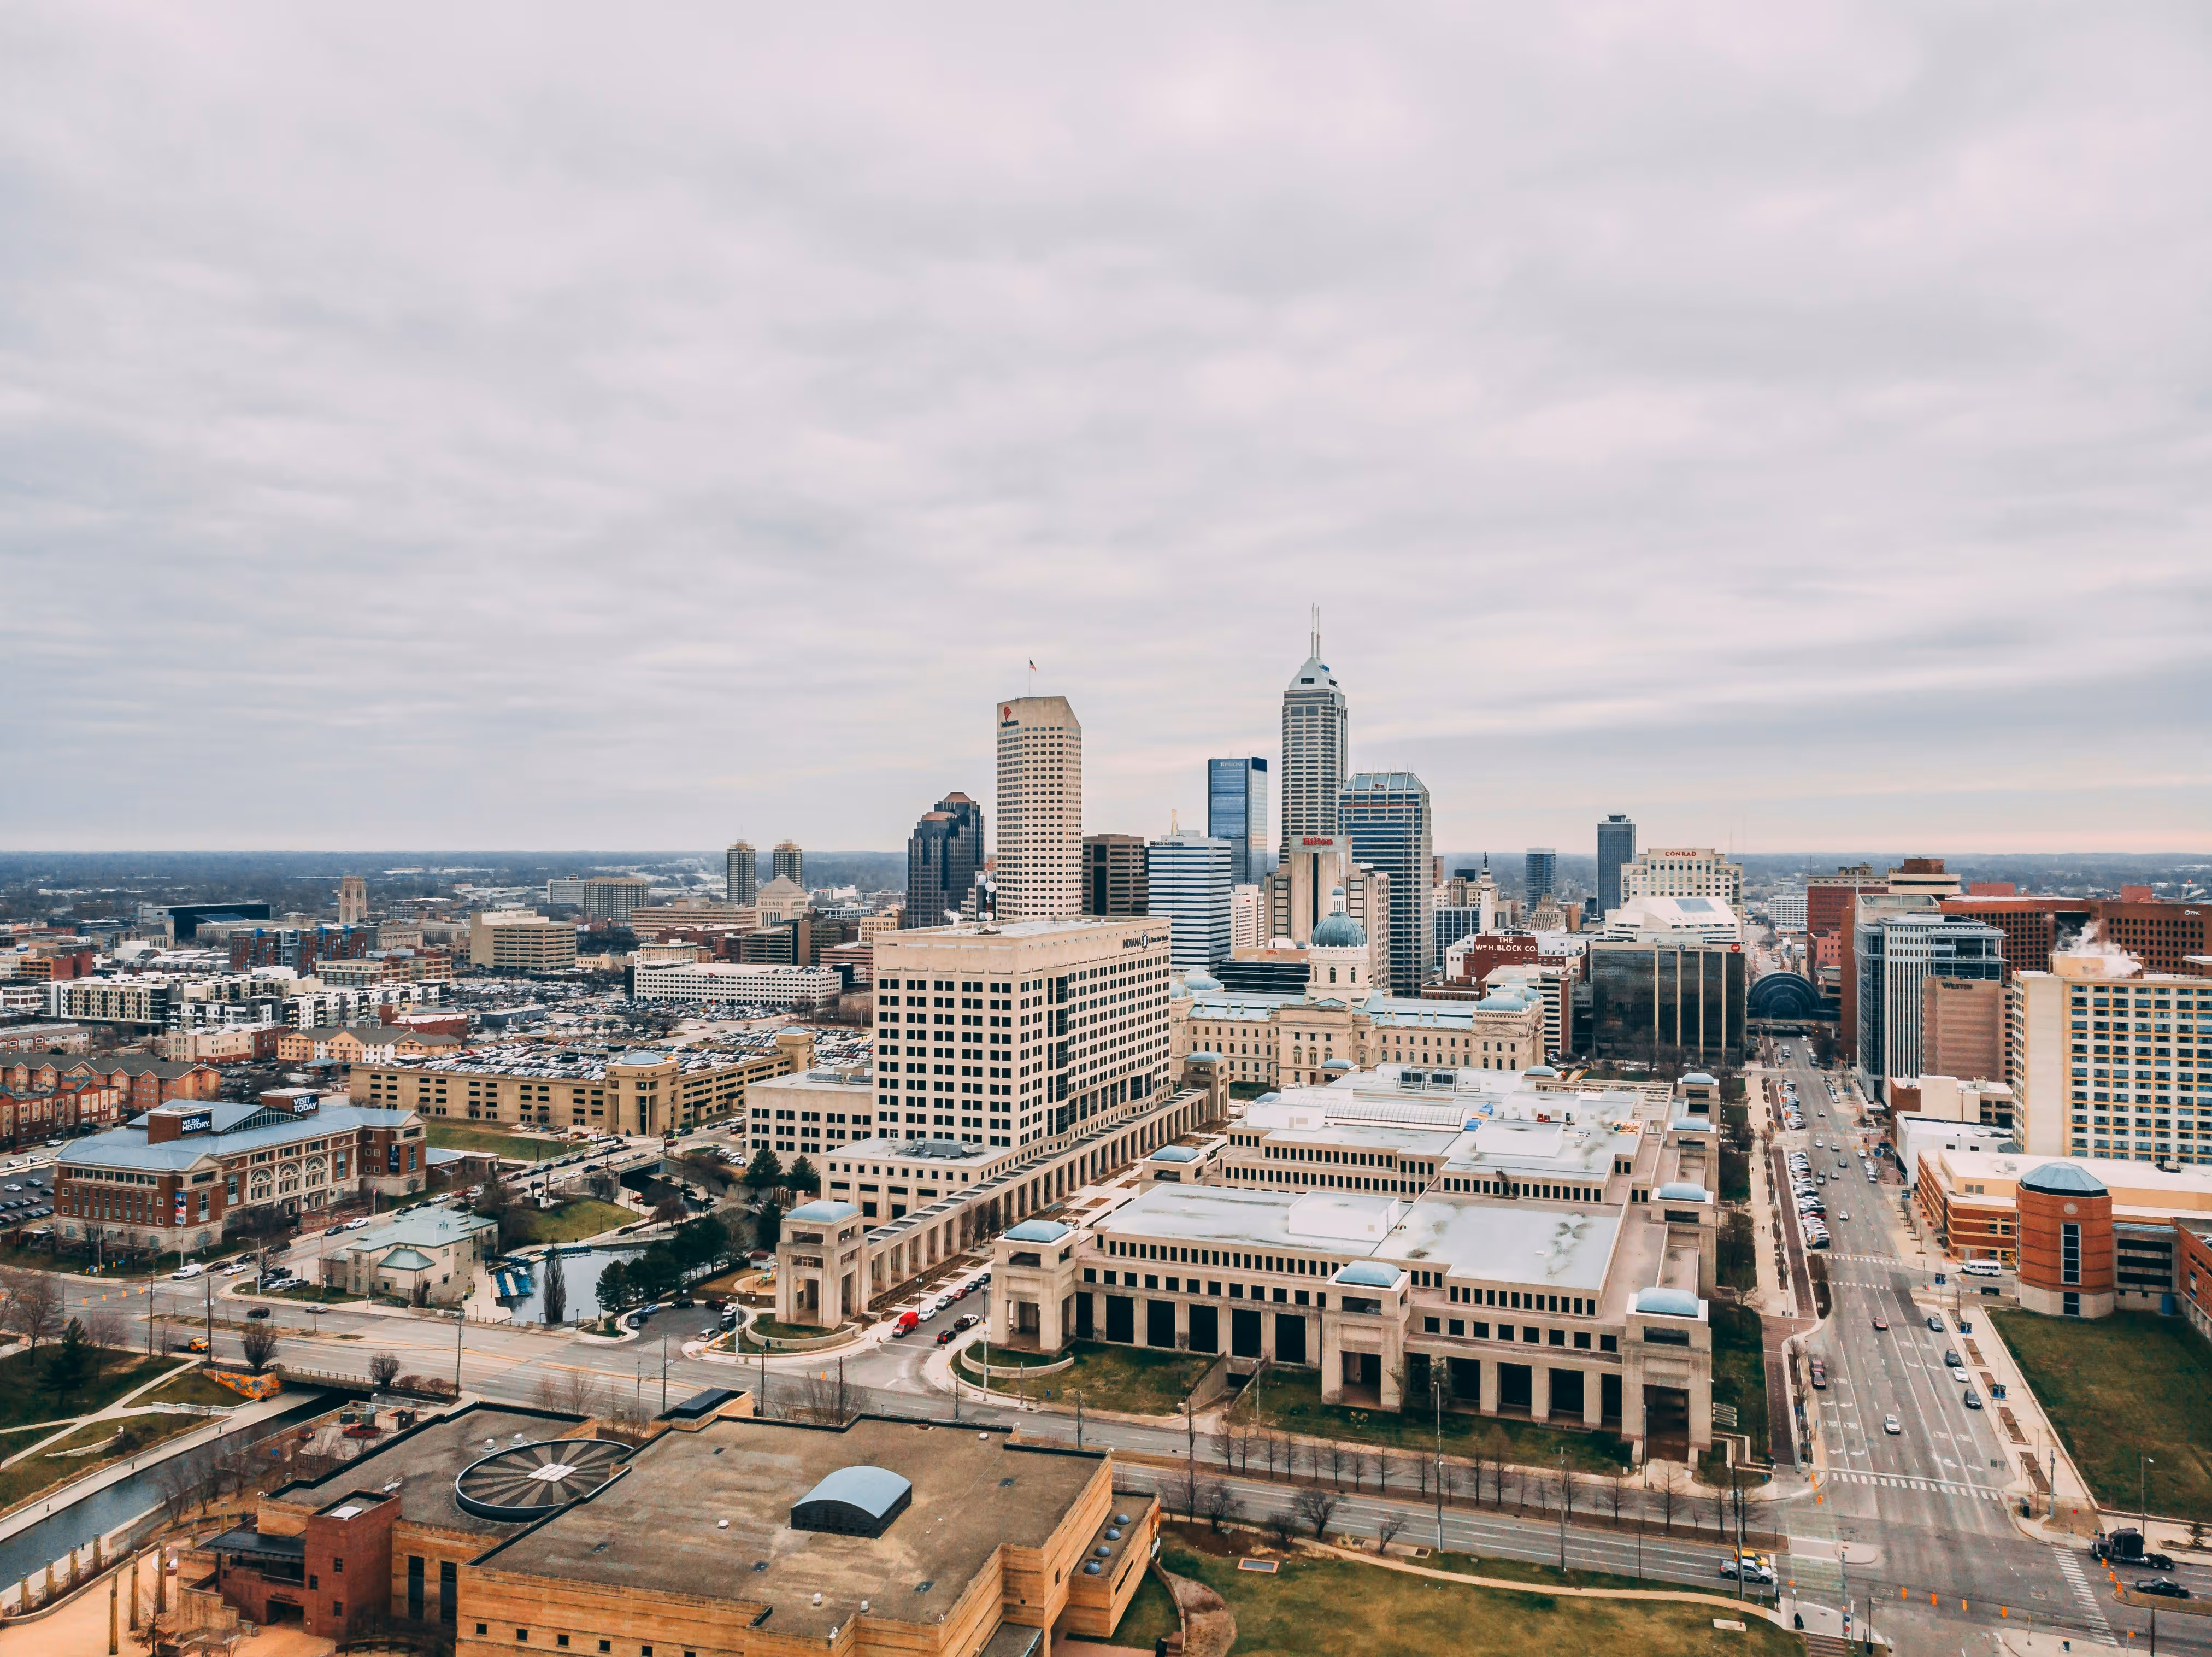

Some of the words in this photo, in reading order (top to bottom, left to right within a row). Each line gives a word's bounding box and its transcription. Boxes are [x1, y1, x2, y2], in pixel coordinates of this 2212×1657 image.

[1303, 836, 1333, 845] Hilton
[1122, 937, 1141, 949] INDIANA
[293, 1096, 310, 1105] VISIT
[293, 1102, 317, 1112] TODAY
[182, 1120, 210, 1131] HISTORY.
